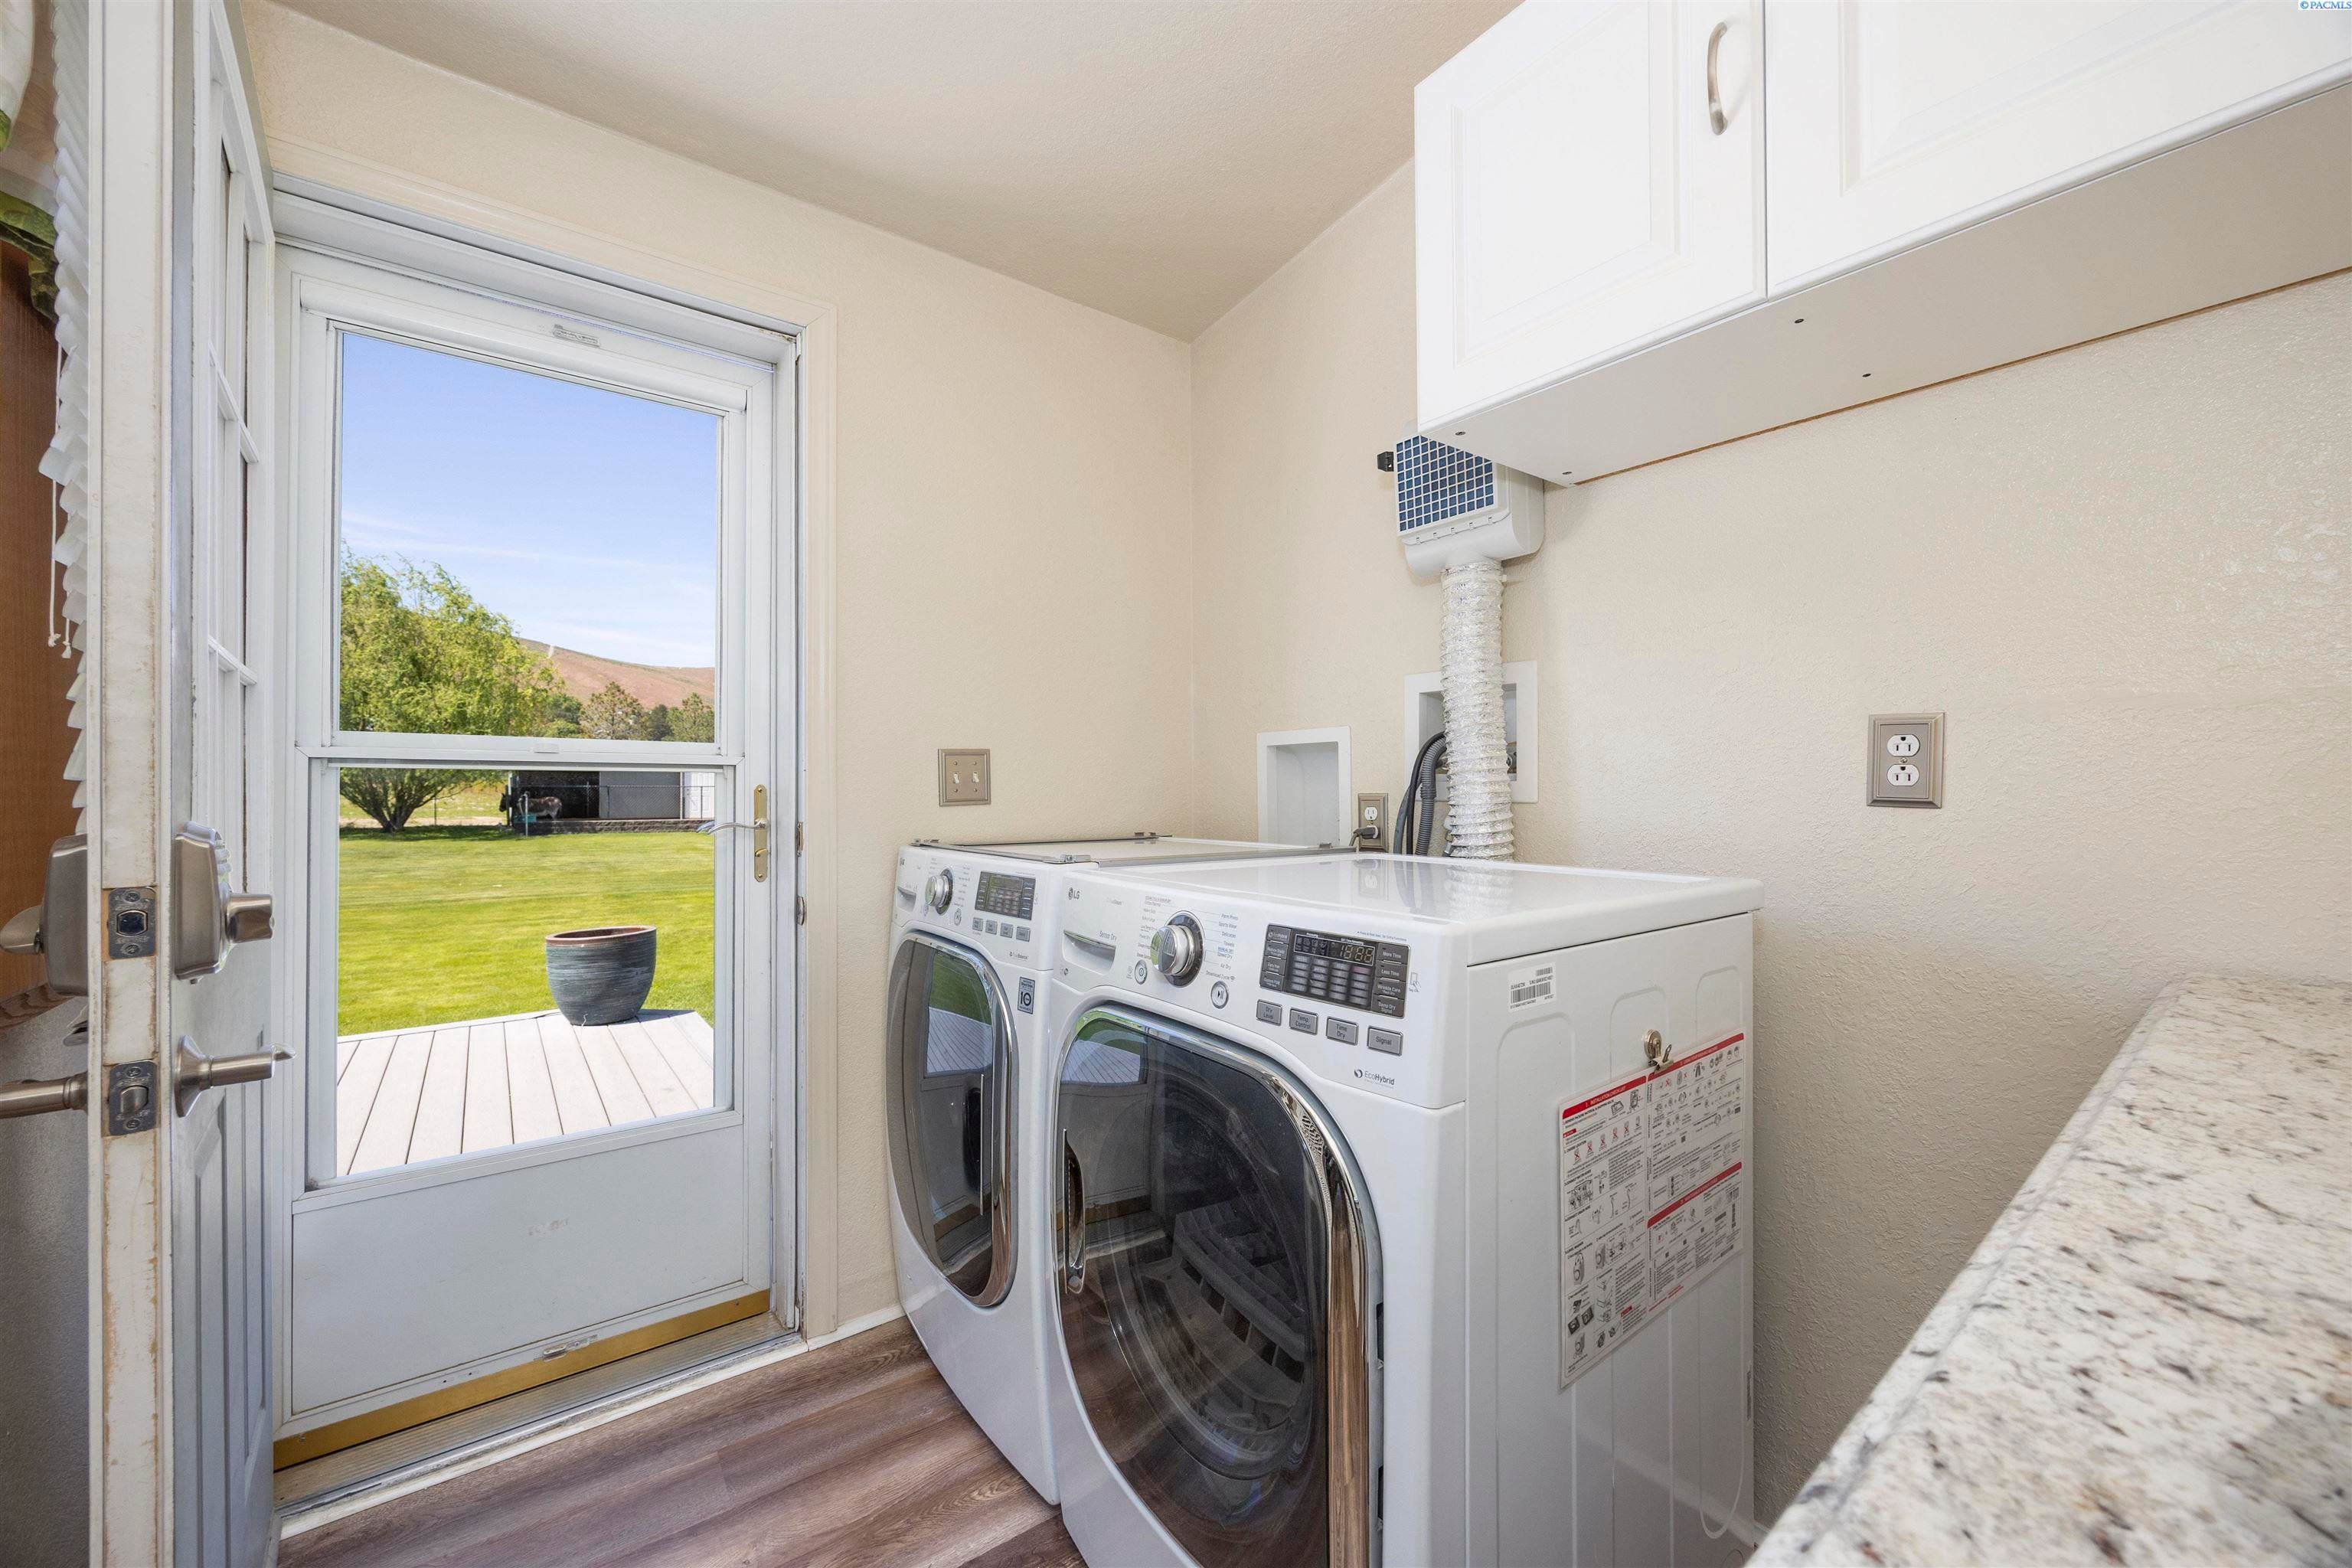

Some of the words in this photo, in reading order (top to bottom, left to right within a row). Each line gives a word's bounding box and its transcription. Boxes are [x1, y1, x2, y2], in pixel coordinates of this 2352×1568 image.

[1099, 930, 1110, 939] Sensor
[1021, 991, 1031, 1006] 10
[1265, 1005, 1273, 1014] Dry
[1297, 1014, 1309, 1023] Temp
[1295, 1021, 1312, 1030] Control
[1336, 1024, 1348, 1032] Time
[1337, 1031, 1345, 1040] Dry
[1376, 1036, 1392, 1046] Signal
[1364, 1070, 1394, 1086] EcoHybrid
